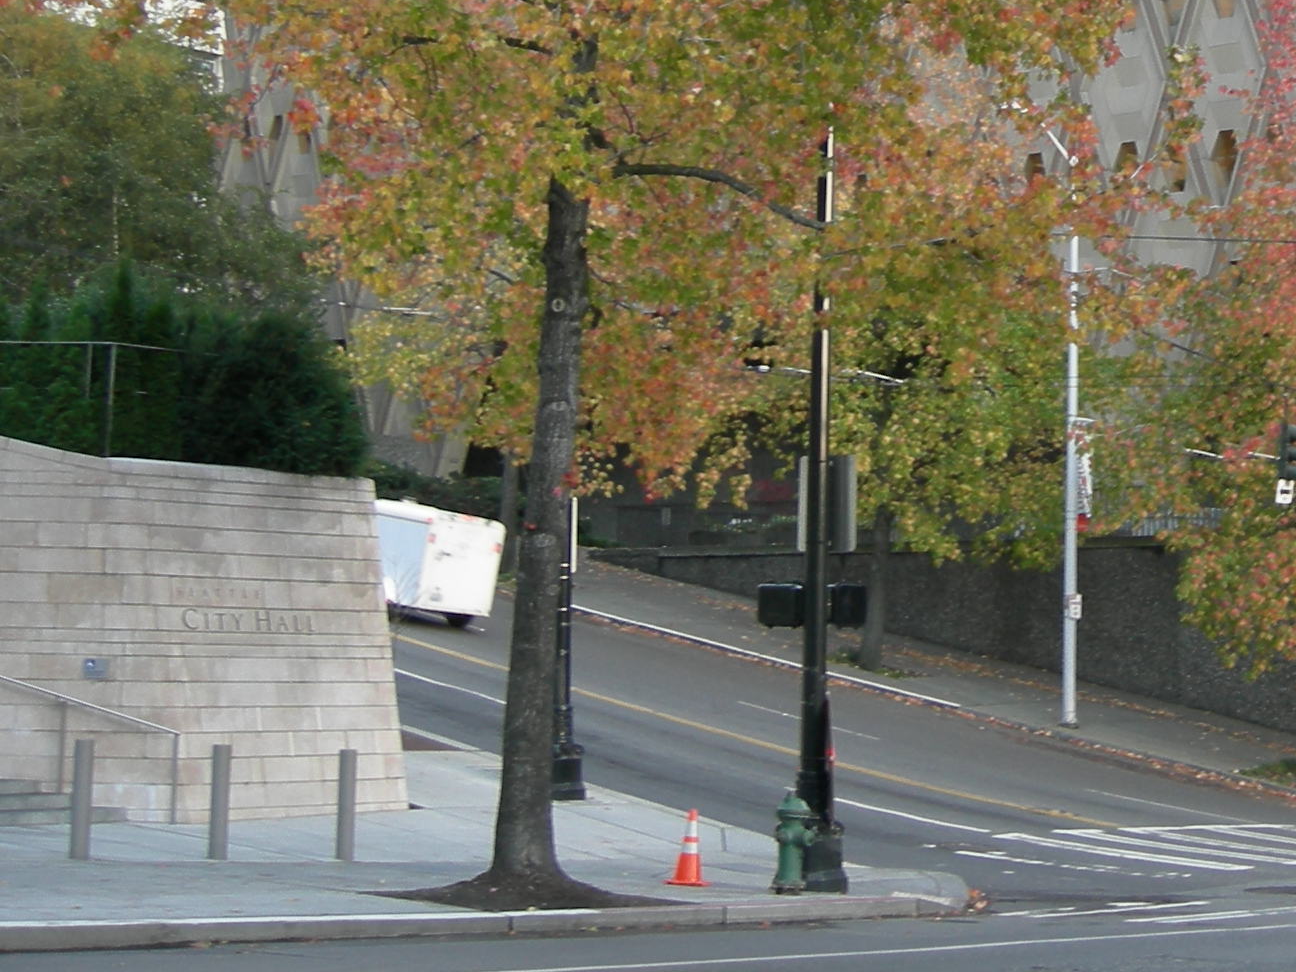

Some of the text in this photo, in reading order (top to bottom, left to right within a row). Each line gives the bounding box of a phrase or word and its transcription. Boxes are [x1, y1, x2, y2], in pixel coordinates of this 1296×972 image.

[175, 587, 263, 599] SEATTLE
[181, 607, 316, 632] CITY HALL
